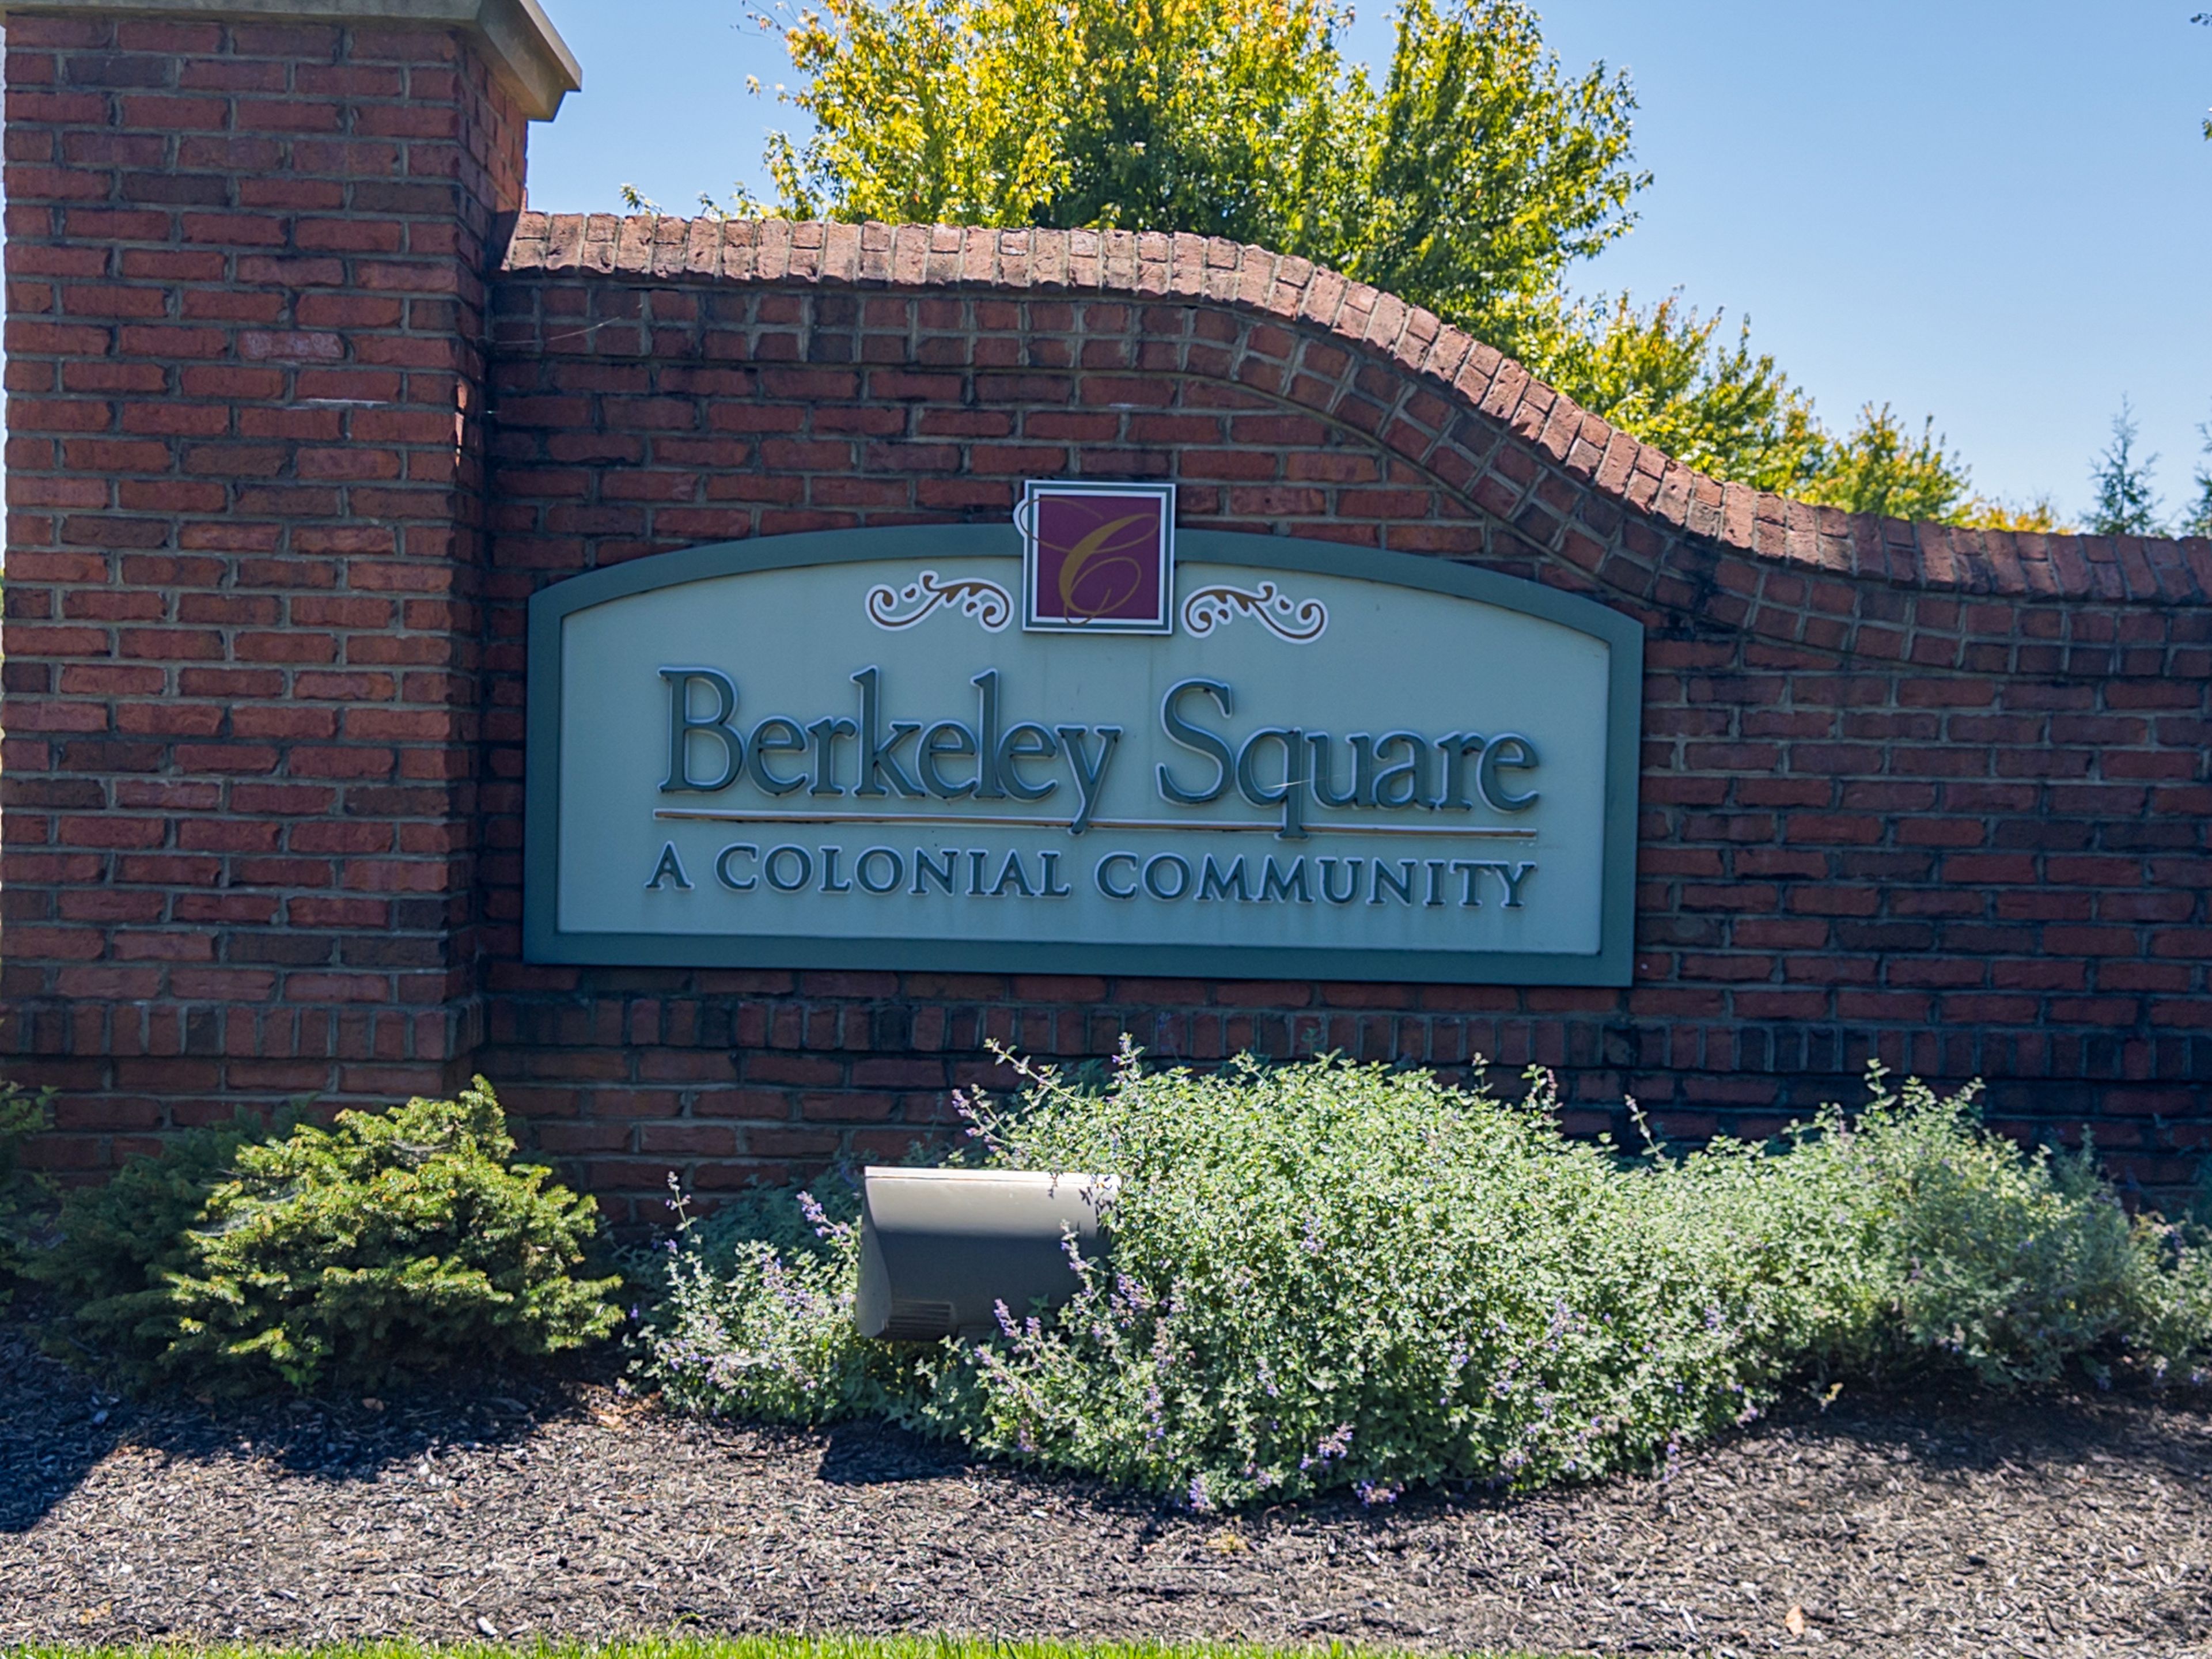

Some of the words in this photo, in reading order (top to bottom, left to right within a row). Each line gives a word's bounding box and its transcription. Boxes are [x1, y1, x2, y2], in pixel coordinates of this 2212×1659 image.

[658, 665, 1122, 834] Berkeley
[1155, 677, 1539, 840] Square
[645, 841, 694, 890] A
[715, 843, 1071, 898] COLONIAL
[1095, 851, 1537, 908] COMMUNITY
